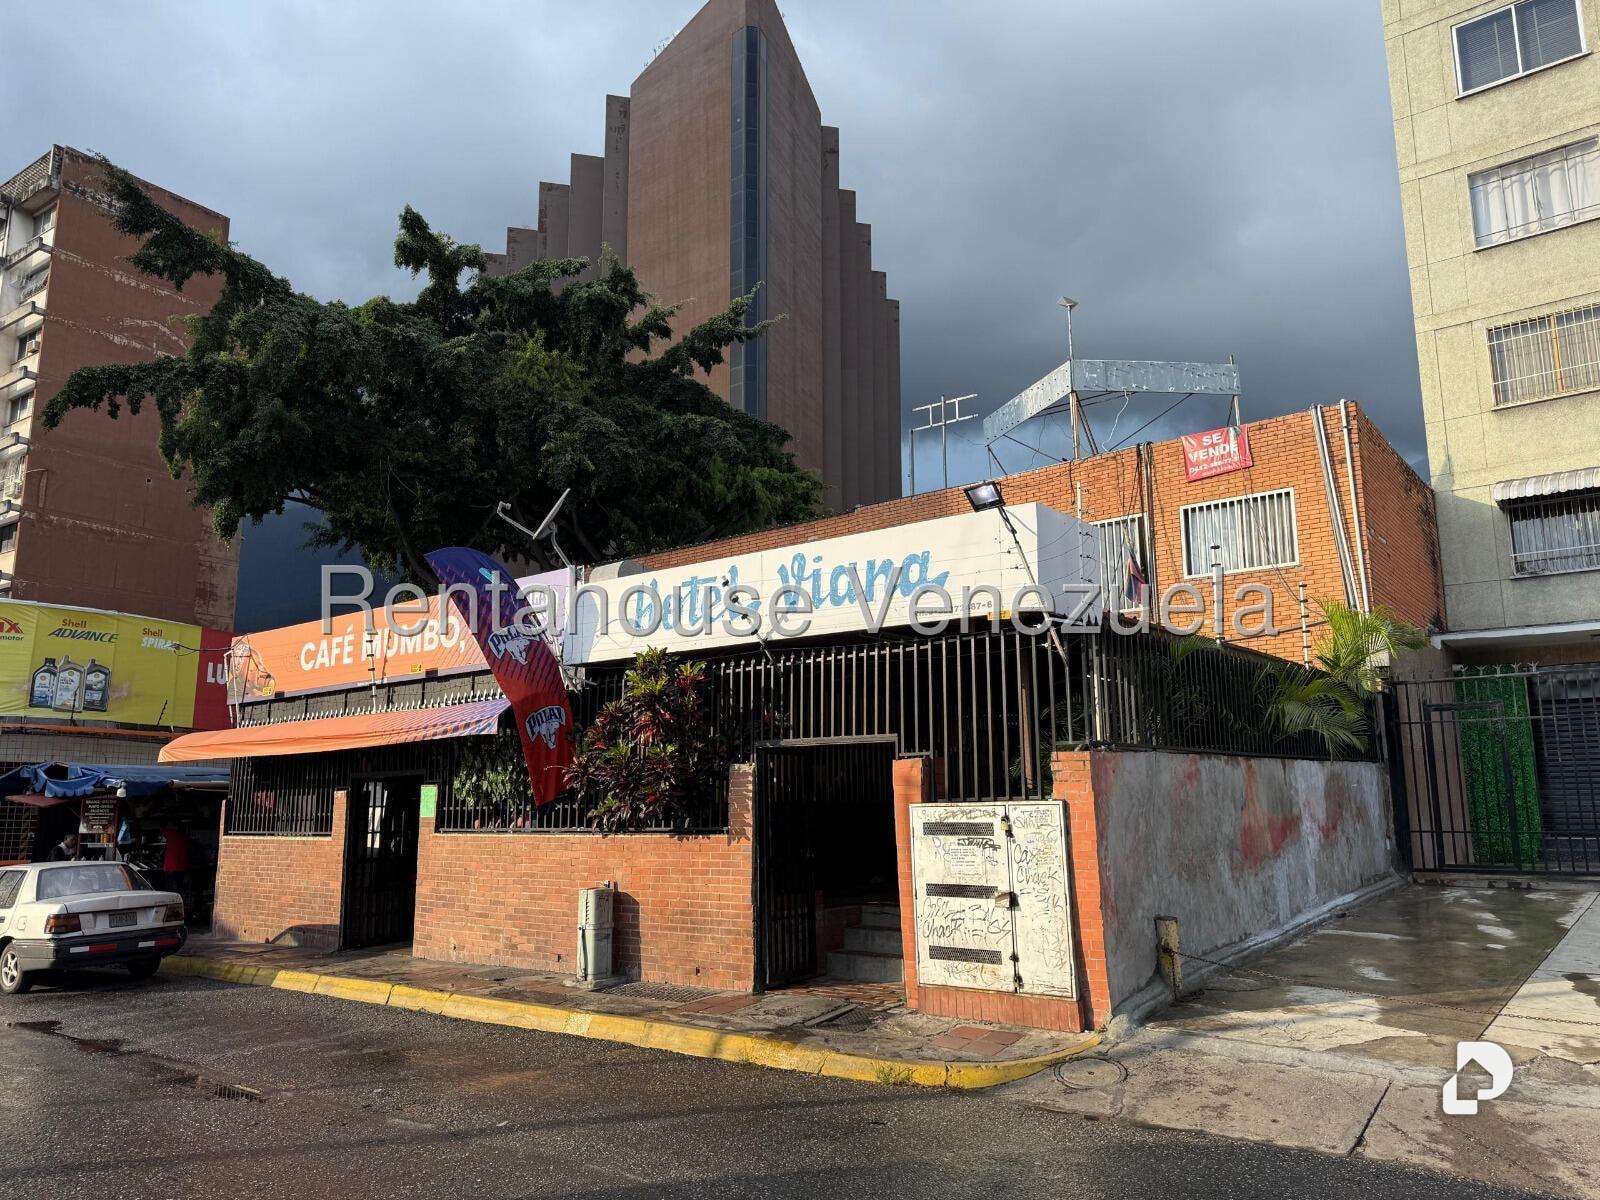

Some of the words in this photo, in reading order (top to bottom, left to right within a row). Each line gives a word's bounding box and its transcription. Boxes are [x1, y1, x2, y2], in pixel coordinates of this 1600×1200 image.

[1202, 432, 1222, 446] SE
[61, 618, 87, 629] Shell
[48, 627, 119, 644] ADVANCE
[142, 627, 163, 637] Shell
[300, 624, 355, 671] CAFÉ
